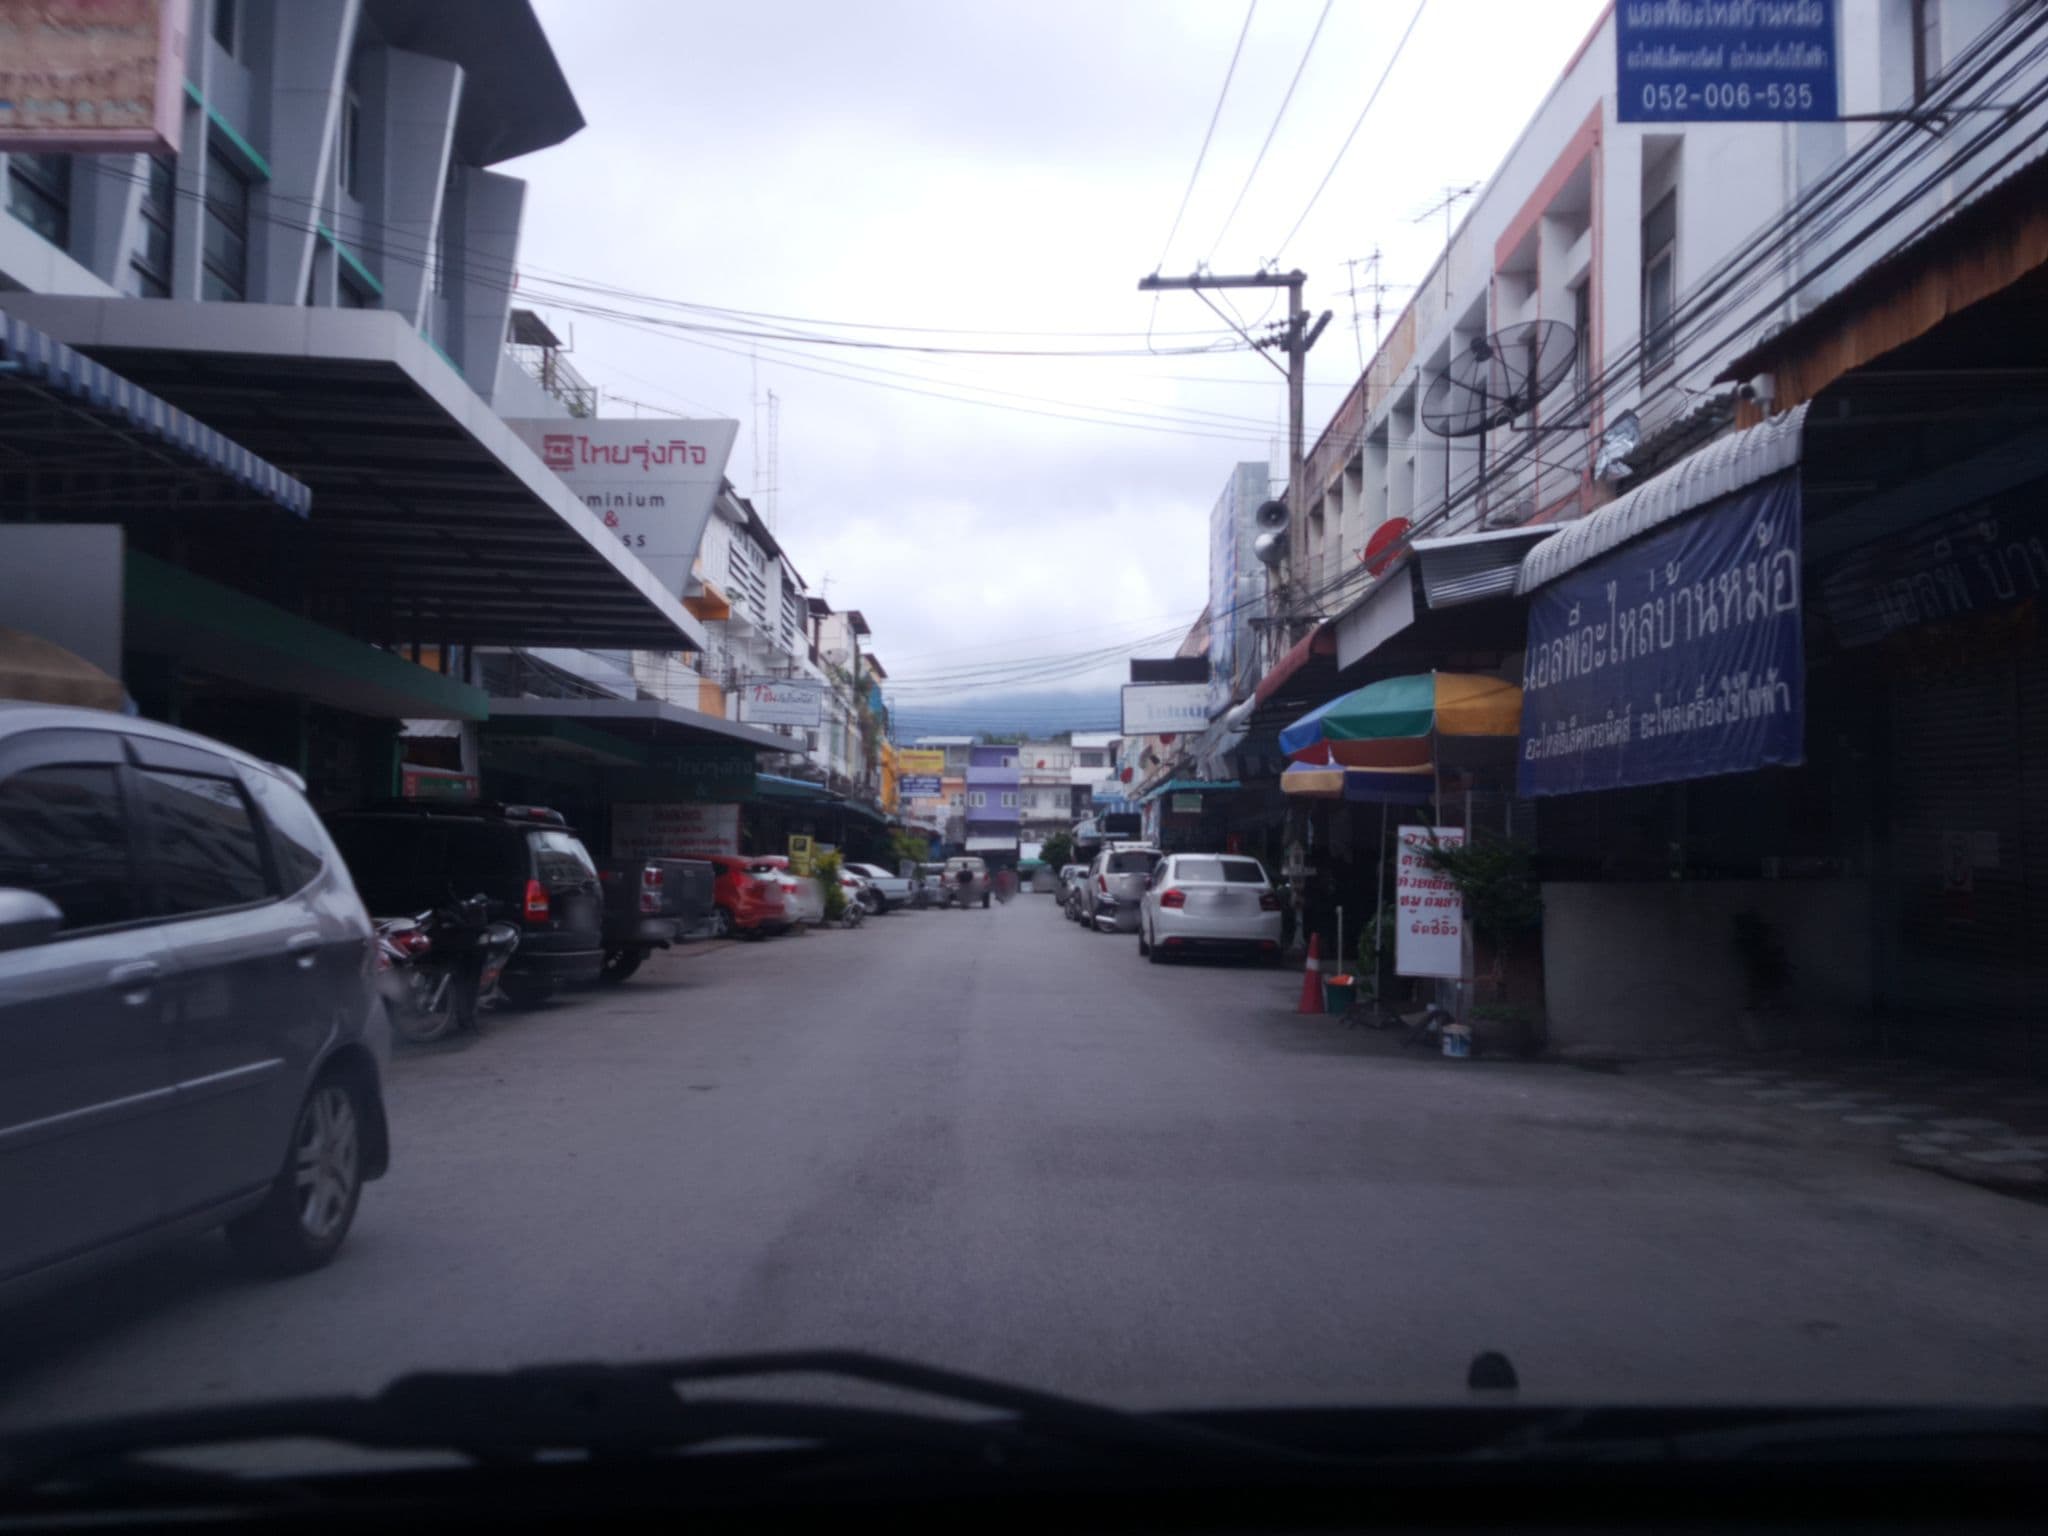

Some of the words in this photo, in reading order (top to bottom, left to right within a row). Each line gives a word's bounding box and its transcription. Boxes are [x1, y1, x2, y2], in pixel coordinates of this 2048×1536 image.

[1642, 83, 1813, 109] 052-006-535
[576, 435, 706, 472] ไทยรุ่งกิจ
